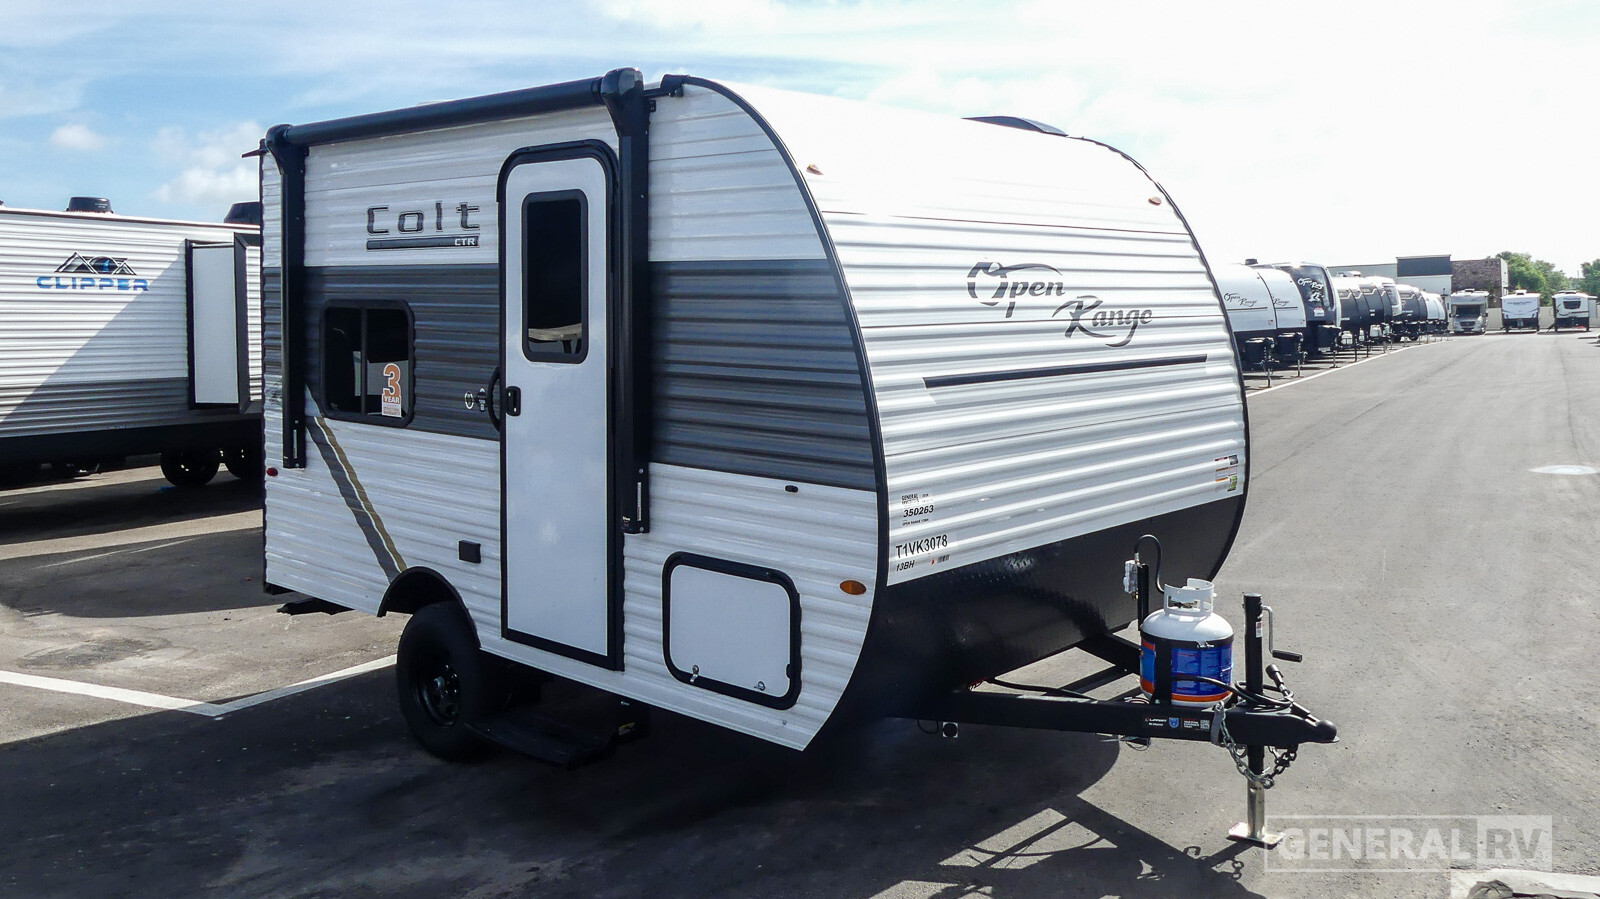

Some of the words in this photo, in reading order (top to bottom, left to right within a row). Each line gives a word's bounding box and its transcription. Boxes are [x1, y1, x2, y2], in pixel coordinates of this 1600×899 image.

[366, 201, 480, 236] Colt
[454, 238, 475, 246] CTR
[36, 276, 149, 291] CLIPPER
[966, 261, 1065, 319] Open
[1223, 292, 1241, 302] Open
[1052, 295, 1153, 348] Range
[383, 363, 401, 397] 3
[383, 396, 400, 404] YEAR
[902, 504, 934, 518] 350263
[895, 534, 948, 558] T1VK3078
[896, 560, 915, 572] 13BH
